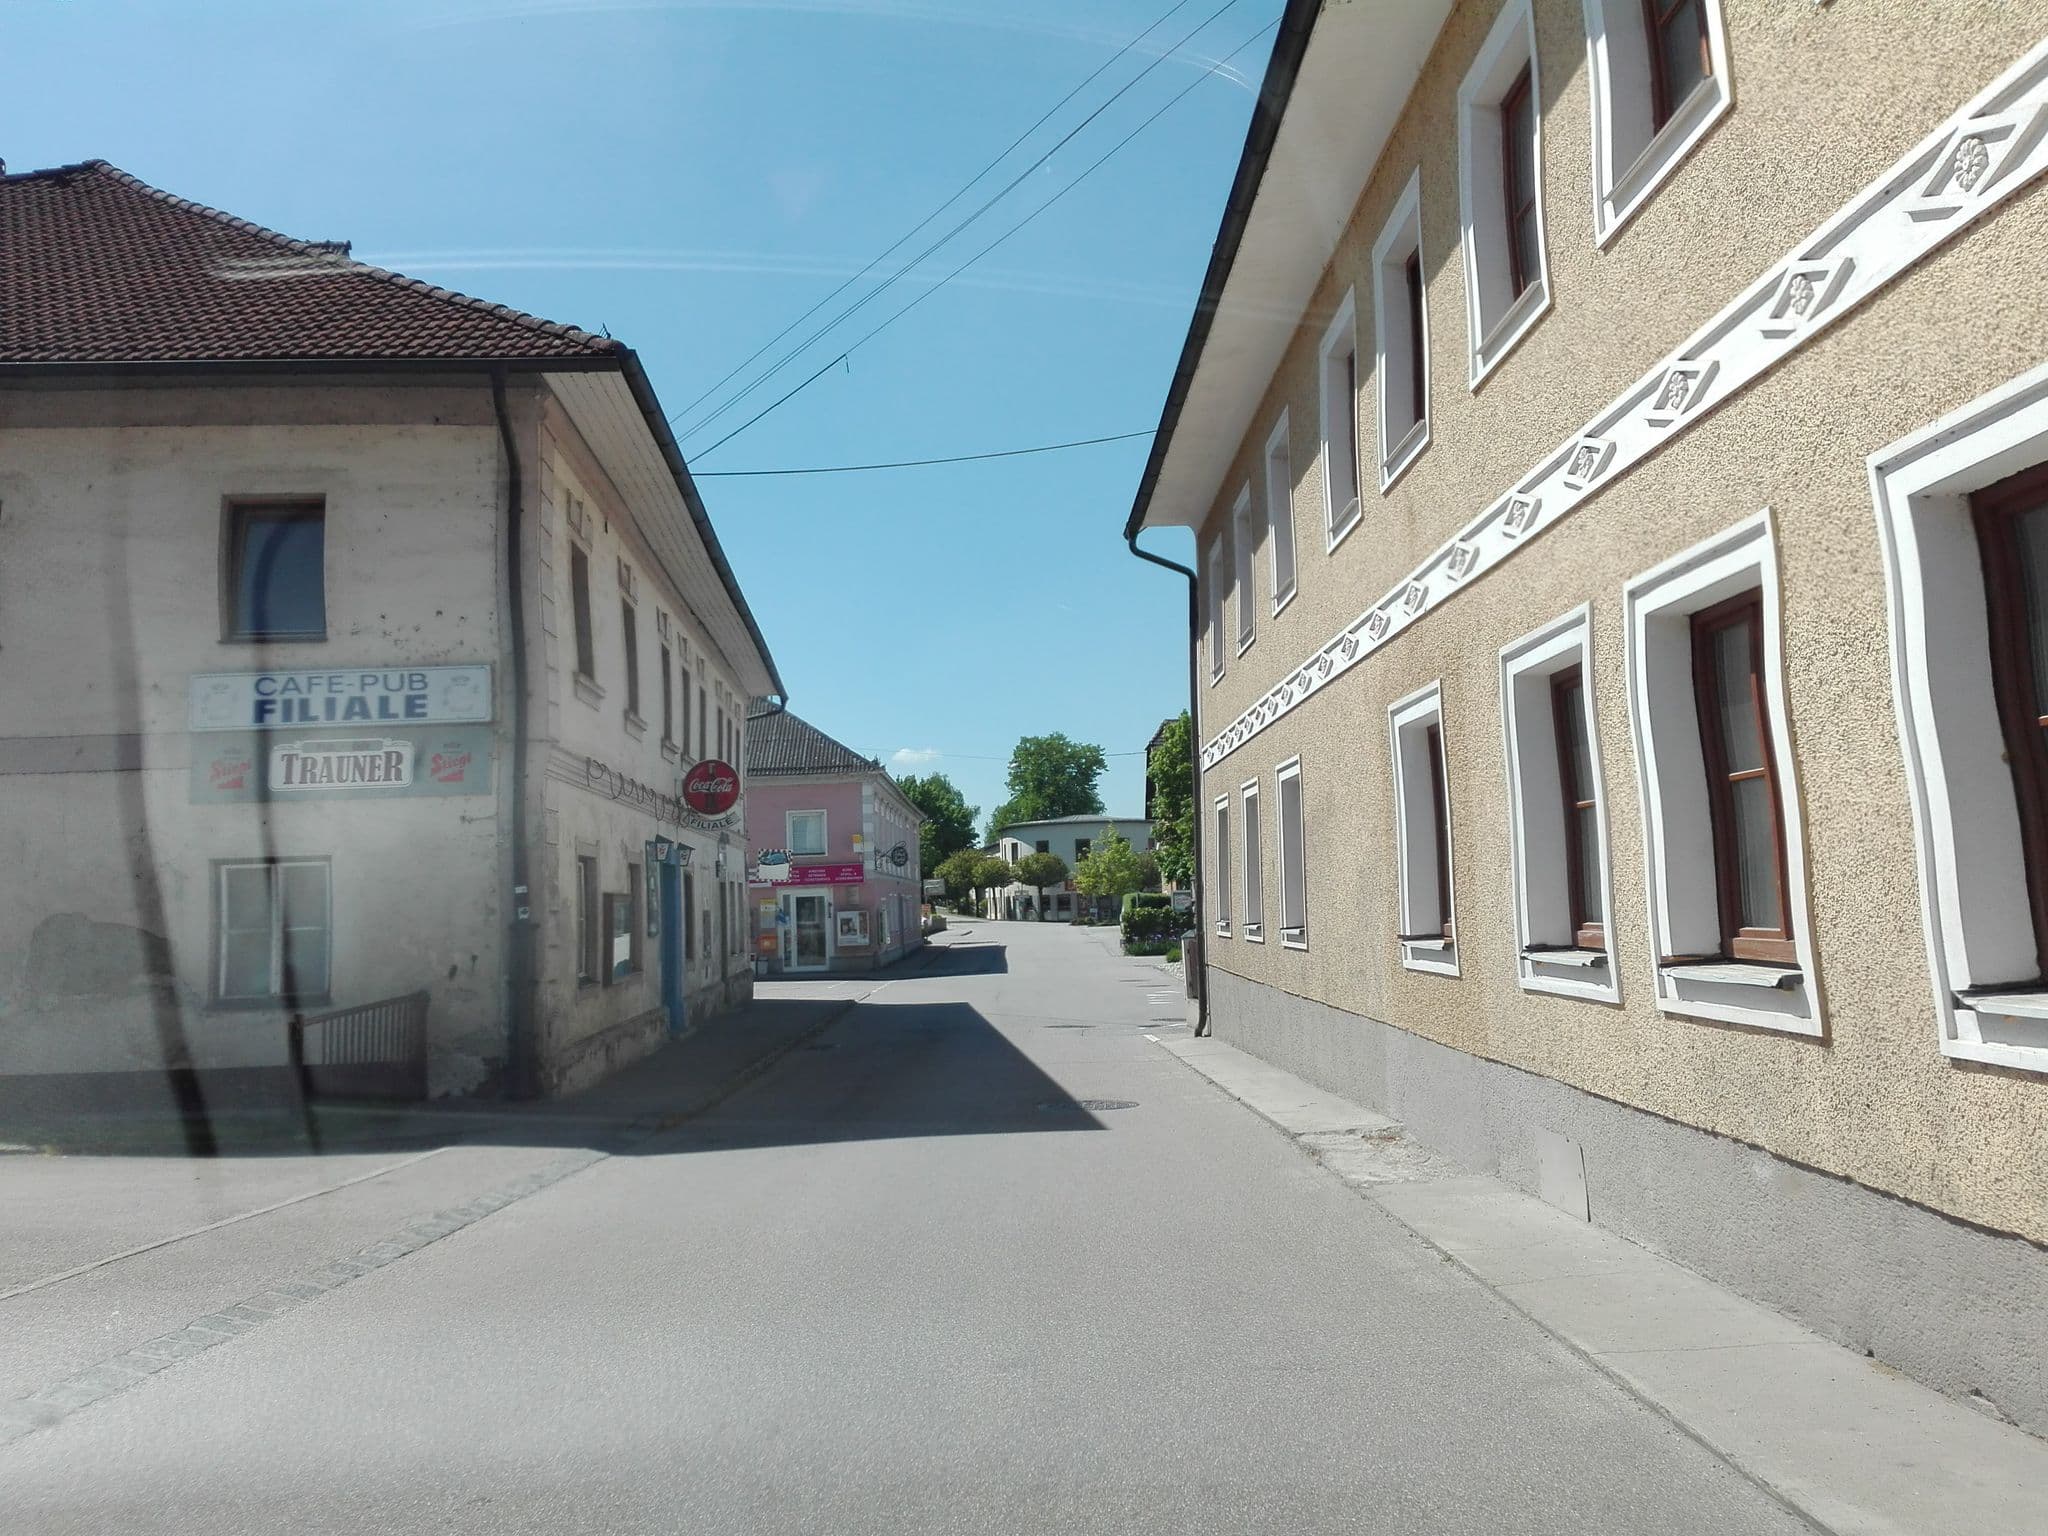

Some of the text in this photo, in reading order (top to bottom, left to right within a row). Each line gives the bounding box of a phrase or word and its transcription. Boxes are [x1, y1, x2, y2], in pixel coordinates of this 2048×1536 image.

[255, 673, 428, 696] CAFE-PUB
[254, 694, 428, 723] FILIALE
[281, 750, 403, 785] TRAUNER
[690, 816, 734, 830] FILIALE
